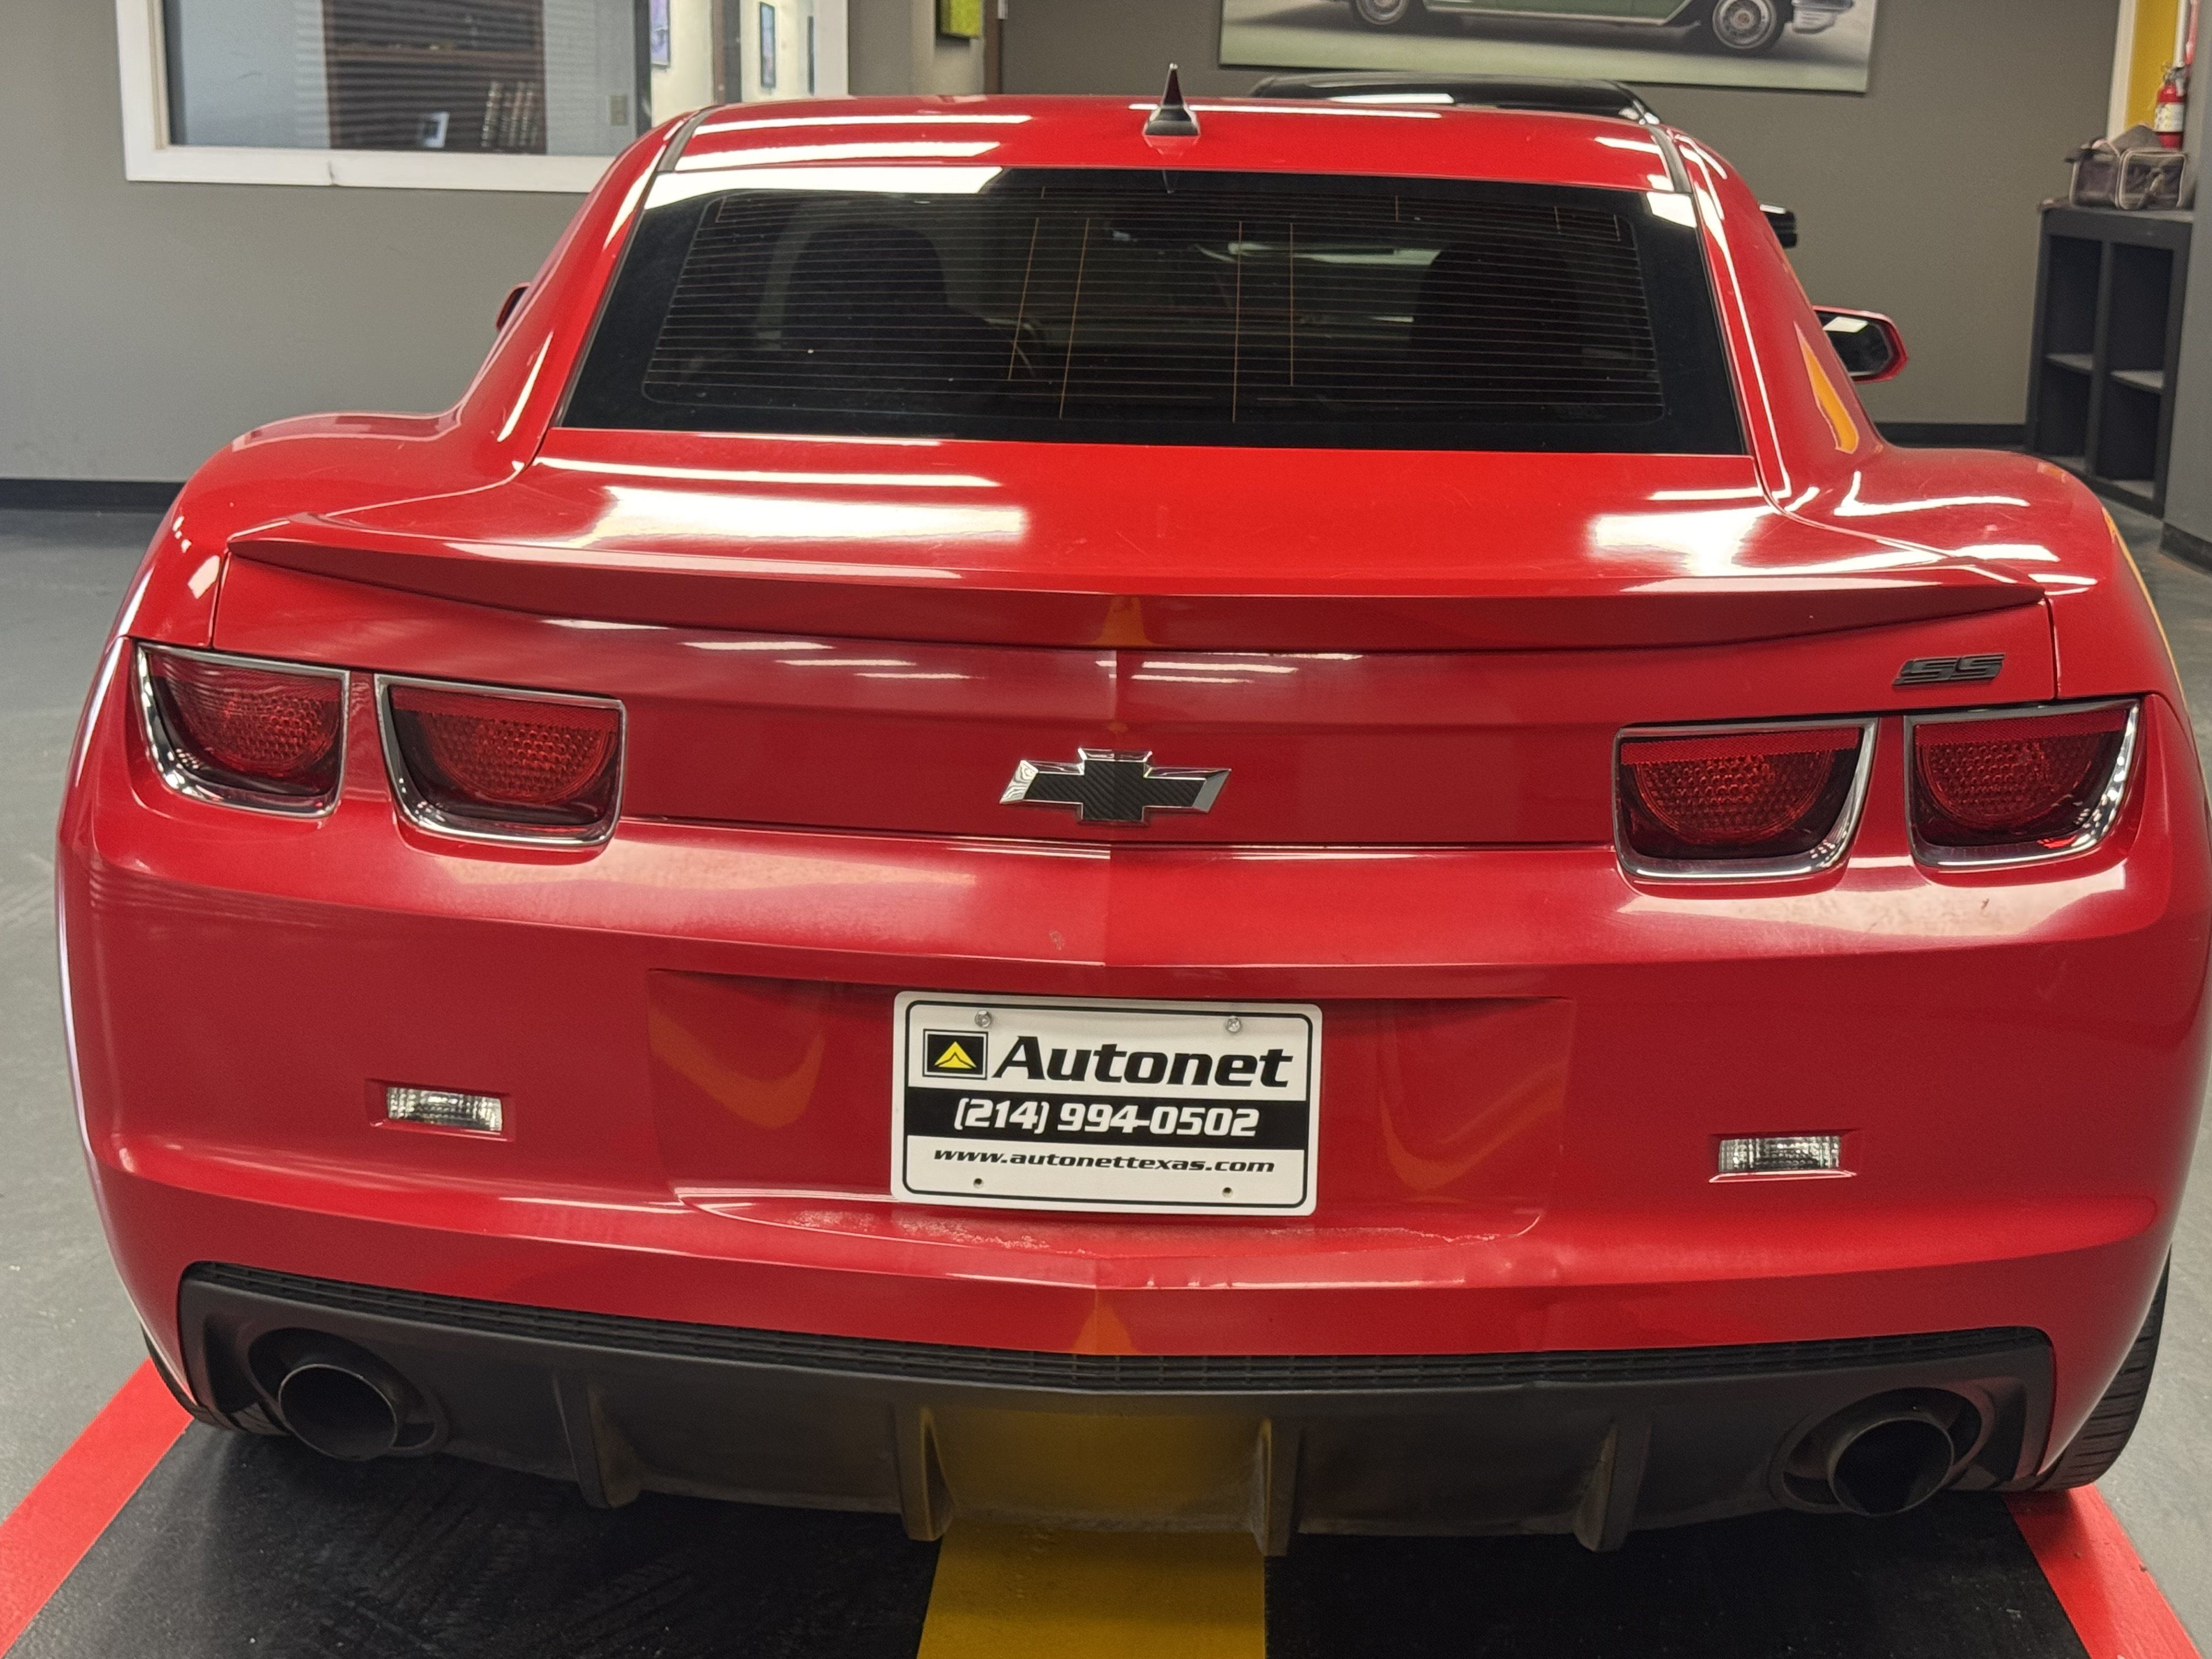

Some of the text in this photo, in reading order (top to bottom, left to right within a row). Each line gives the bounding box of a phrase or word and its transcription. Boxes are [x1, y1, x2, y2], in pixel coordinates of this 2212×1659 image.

[1892, 652, 2006, 686] SS
[992, 1035, 1294, 1088] Autonet
[954, 1098, 1260, 1137] (214) 994-0502
[934, 1149, 1275, 1172] www.autonettexas.com
